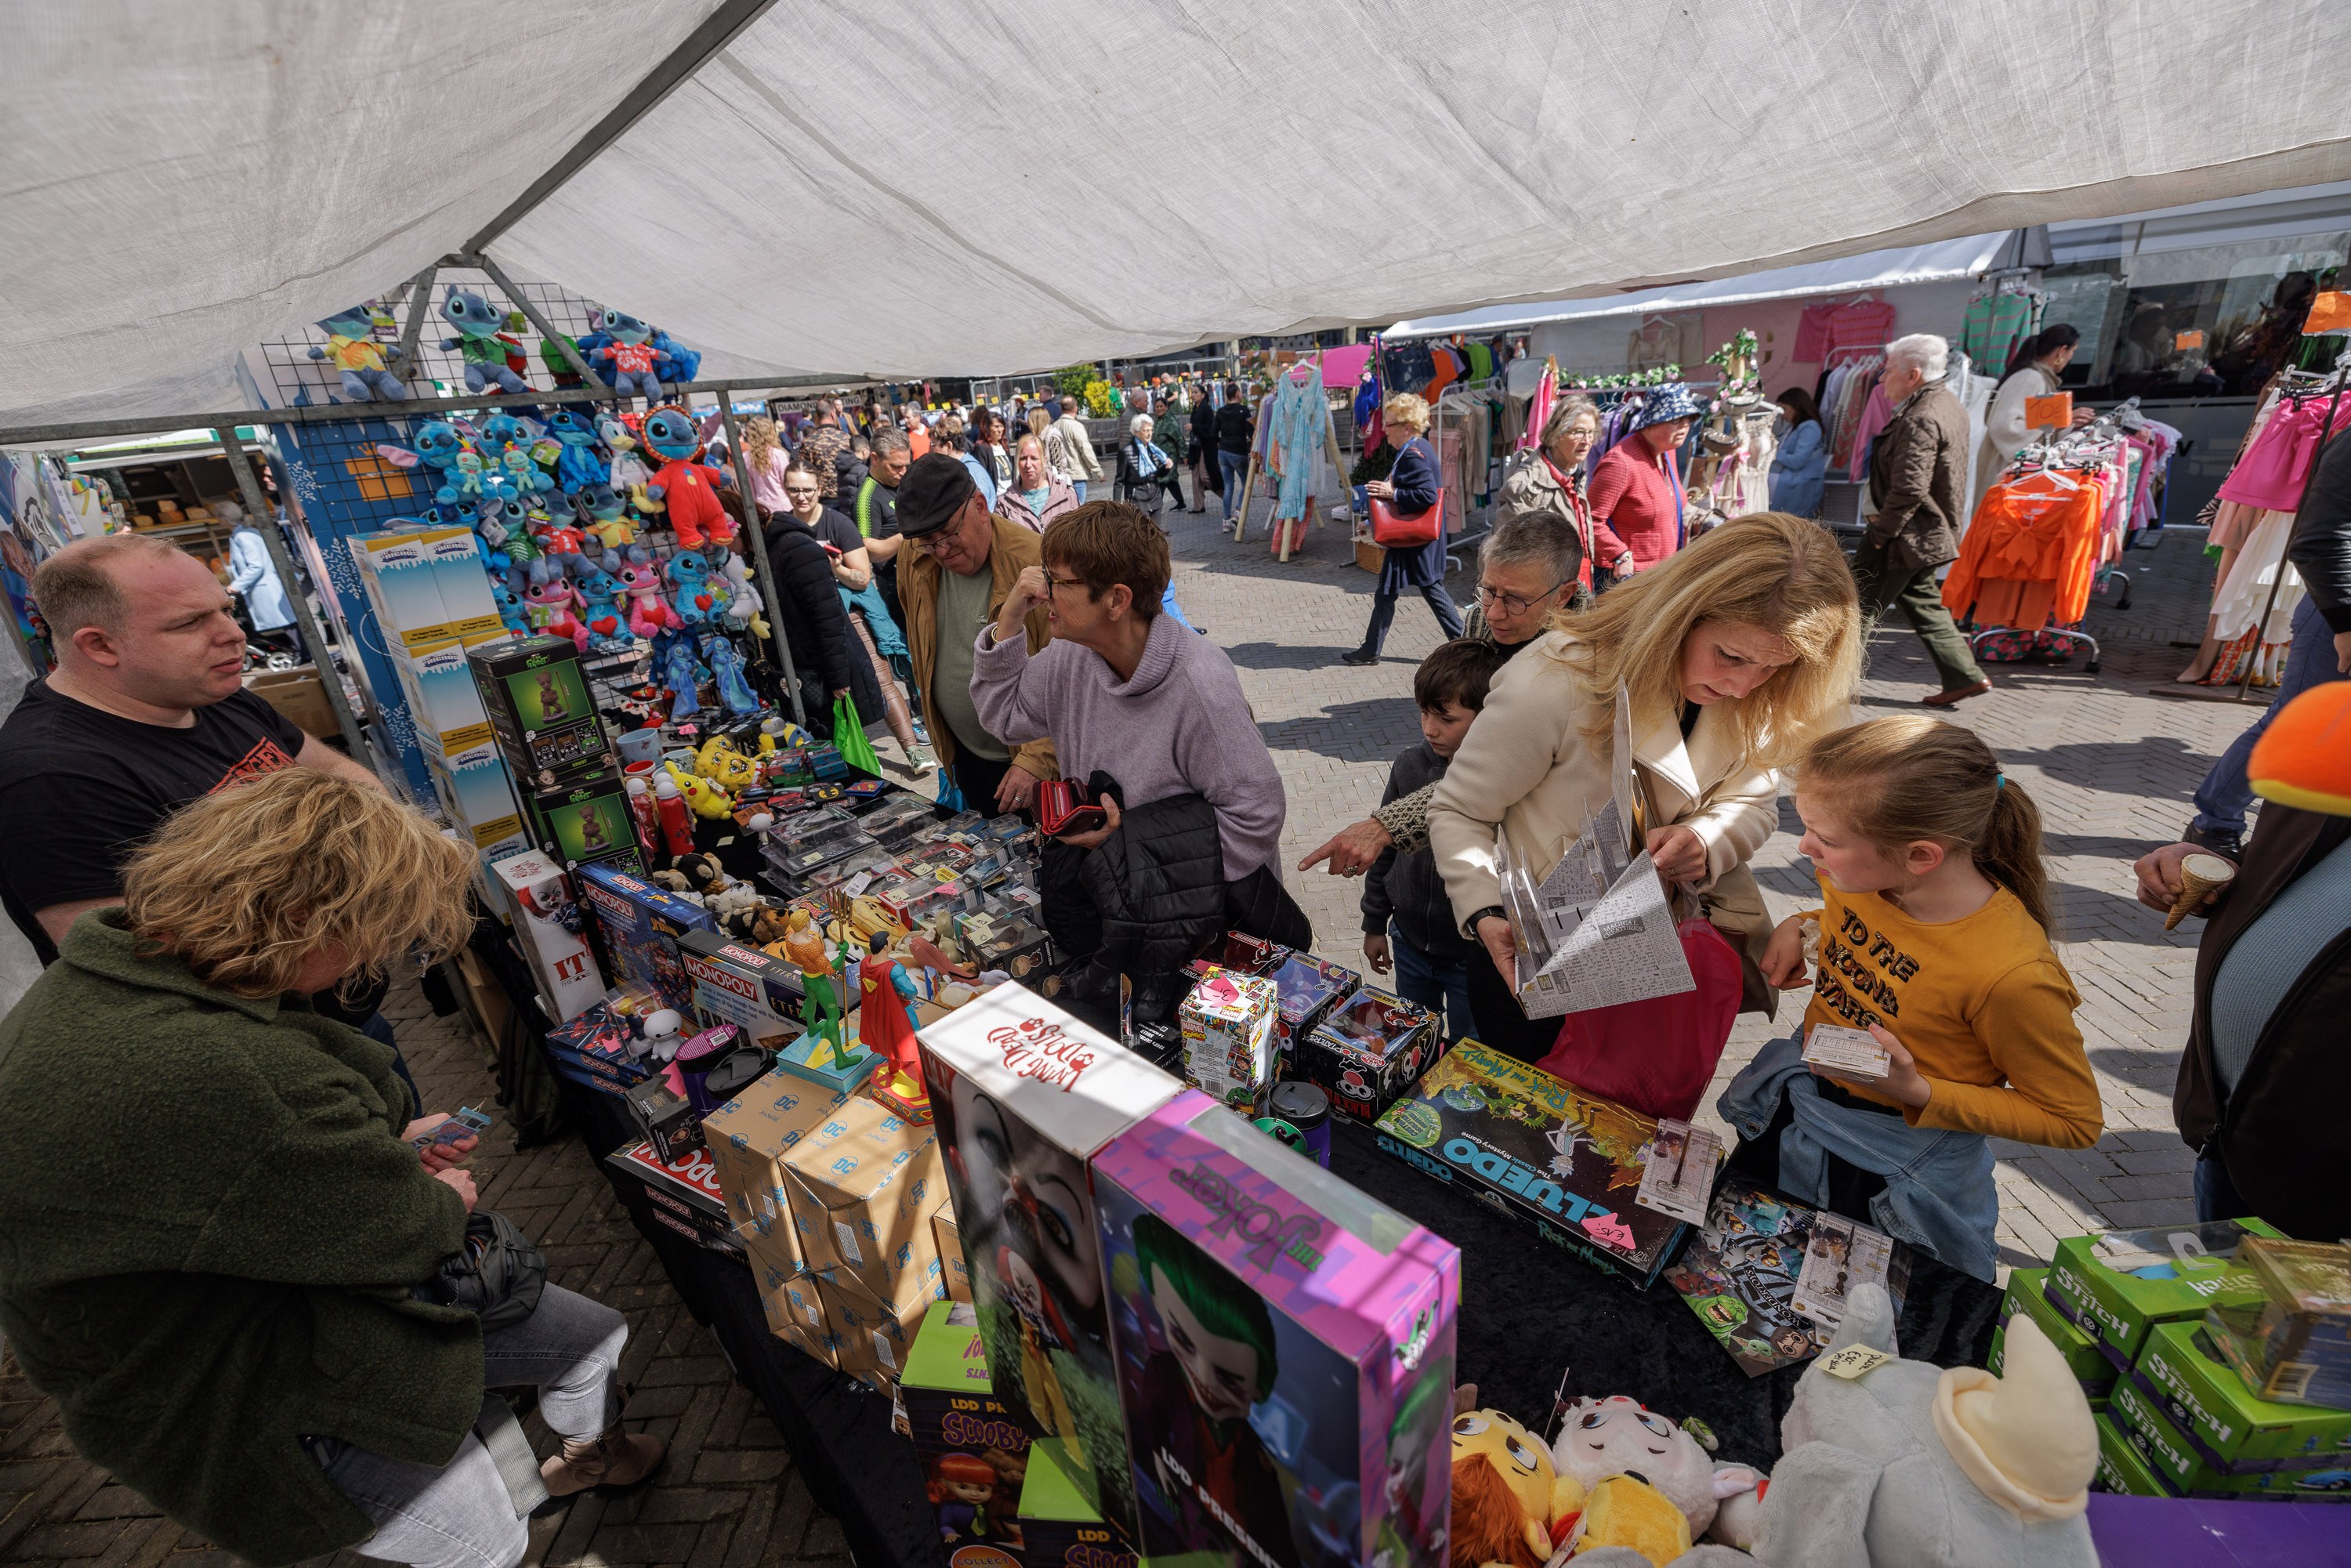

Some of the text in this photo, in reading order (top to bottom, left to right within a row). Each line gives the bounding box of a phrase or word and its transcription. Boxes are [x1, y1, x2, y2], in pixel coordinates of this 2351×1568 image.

[614, 875, 644, 892] MONOPOLY
[588, 887, 633, 920] MONOPOLY
[1603, 919, 1638, 932] MAGICAL
[1603, 925, 1643, 940] CREATURES
[1841, 906, 1919, 983] TO THE
[552, 951, 585, 980] IT
[720, 947, 768, 967] MONOPOLY
[687, 961, 755, 999] MONOPOLY
[769, 966, 804, 985] ETERNA
[1815, 966, 1884, 1030] STARS
[1182, 1021, 1204, 1033] MARVEL
[1182, 1030, 1207, 1039] COMICS
[1310, 1034, 1358, 1060] POPTATERS
[583, 1057, 617, 1075] MONOPOLY
[1494, 1052, 1526, 1070] BLACKOUT
[1535, 1070, 1549, 1080] BACK
[777, 1095, 798, 1111] DC
[1342, 1098, 1371, 1118] BLACK
[824, 1122, 846, 1139] DC
[881, 1116, 904, 1131] DC
[1394, 1116, 1417, 1138] CUSTOM
[1401, 1114, 1424, 1135] SCULPTED
[1461, 1132, 1481, 1147] Game
[1377, 1135, 1453, 1181] CLUEDO
[1481, 1140, 1512, 1161] Mystery
[833, 1158, 857, 1175] DC
[1536, 1168, 1551, 1180] The
[648, 1189, 690, 1215] MONOPOLY
[911, 1179, 927, 1205] DC
[657, 1211, 697, 1239] MONOPOLY
[896, 1242, 913, 1267] DC
[1287, 1240, 1325, 1273] THE
[1746, 1268, 1800, 1326] WONDERTOYS
[951, 1398, 980, 1410] LDD
[942, 1411, 1033, 1451] SCOOBY-
[1161, 1446, 1192, 1487] LDD
[1077, 1530, 1110, 1542] LDD
[956, 1556, 1010, 1566] COLLECT
